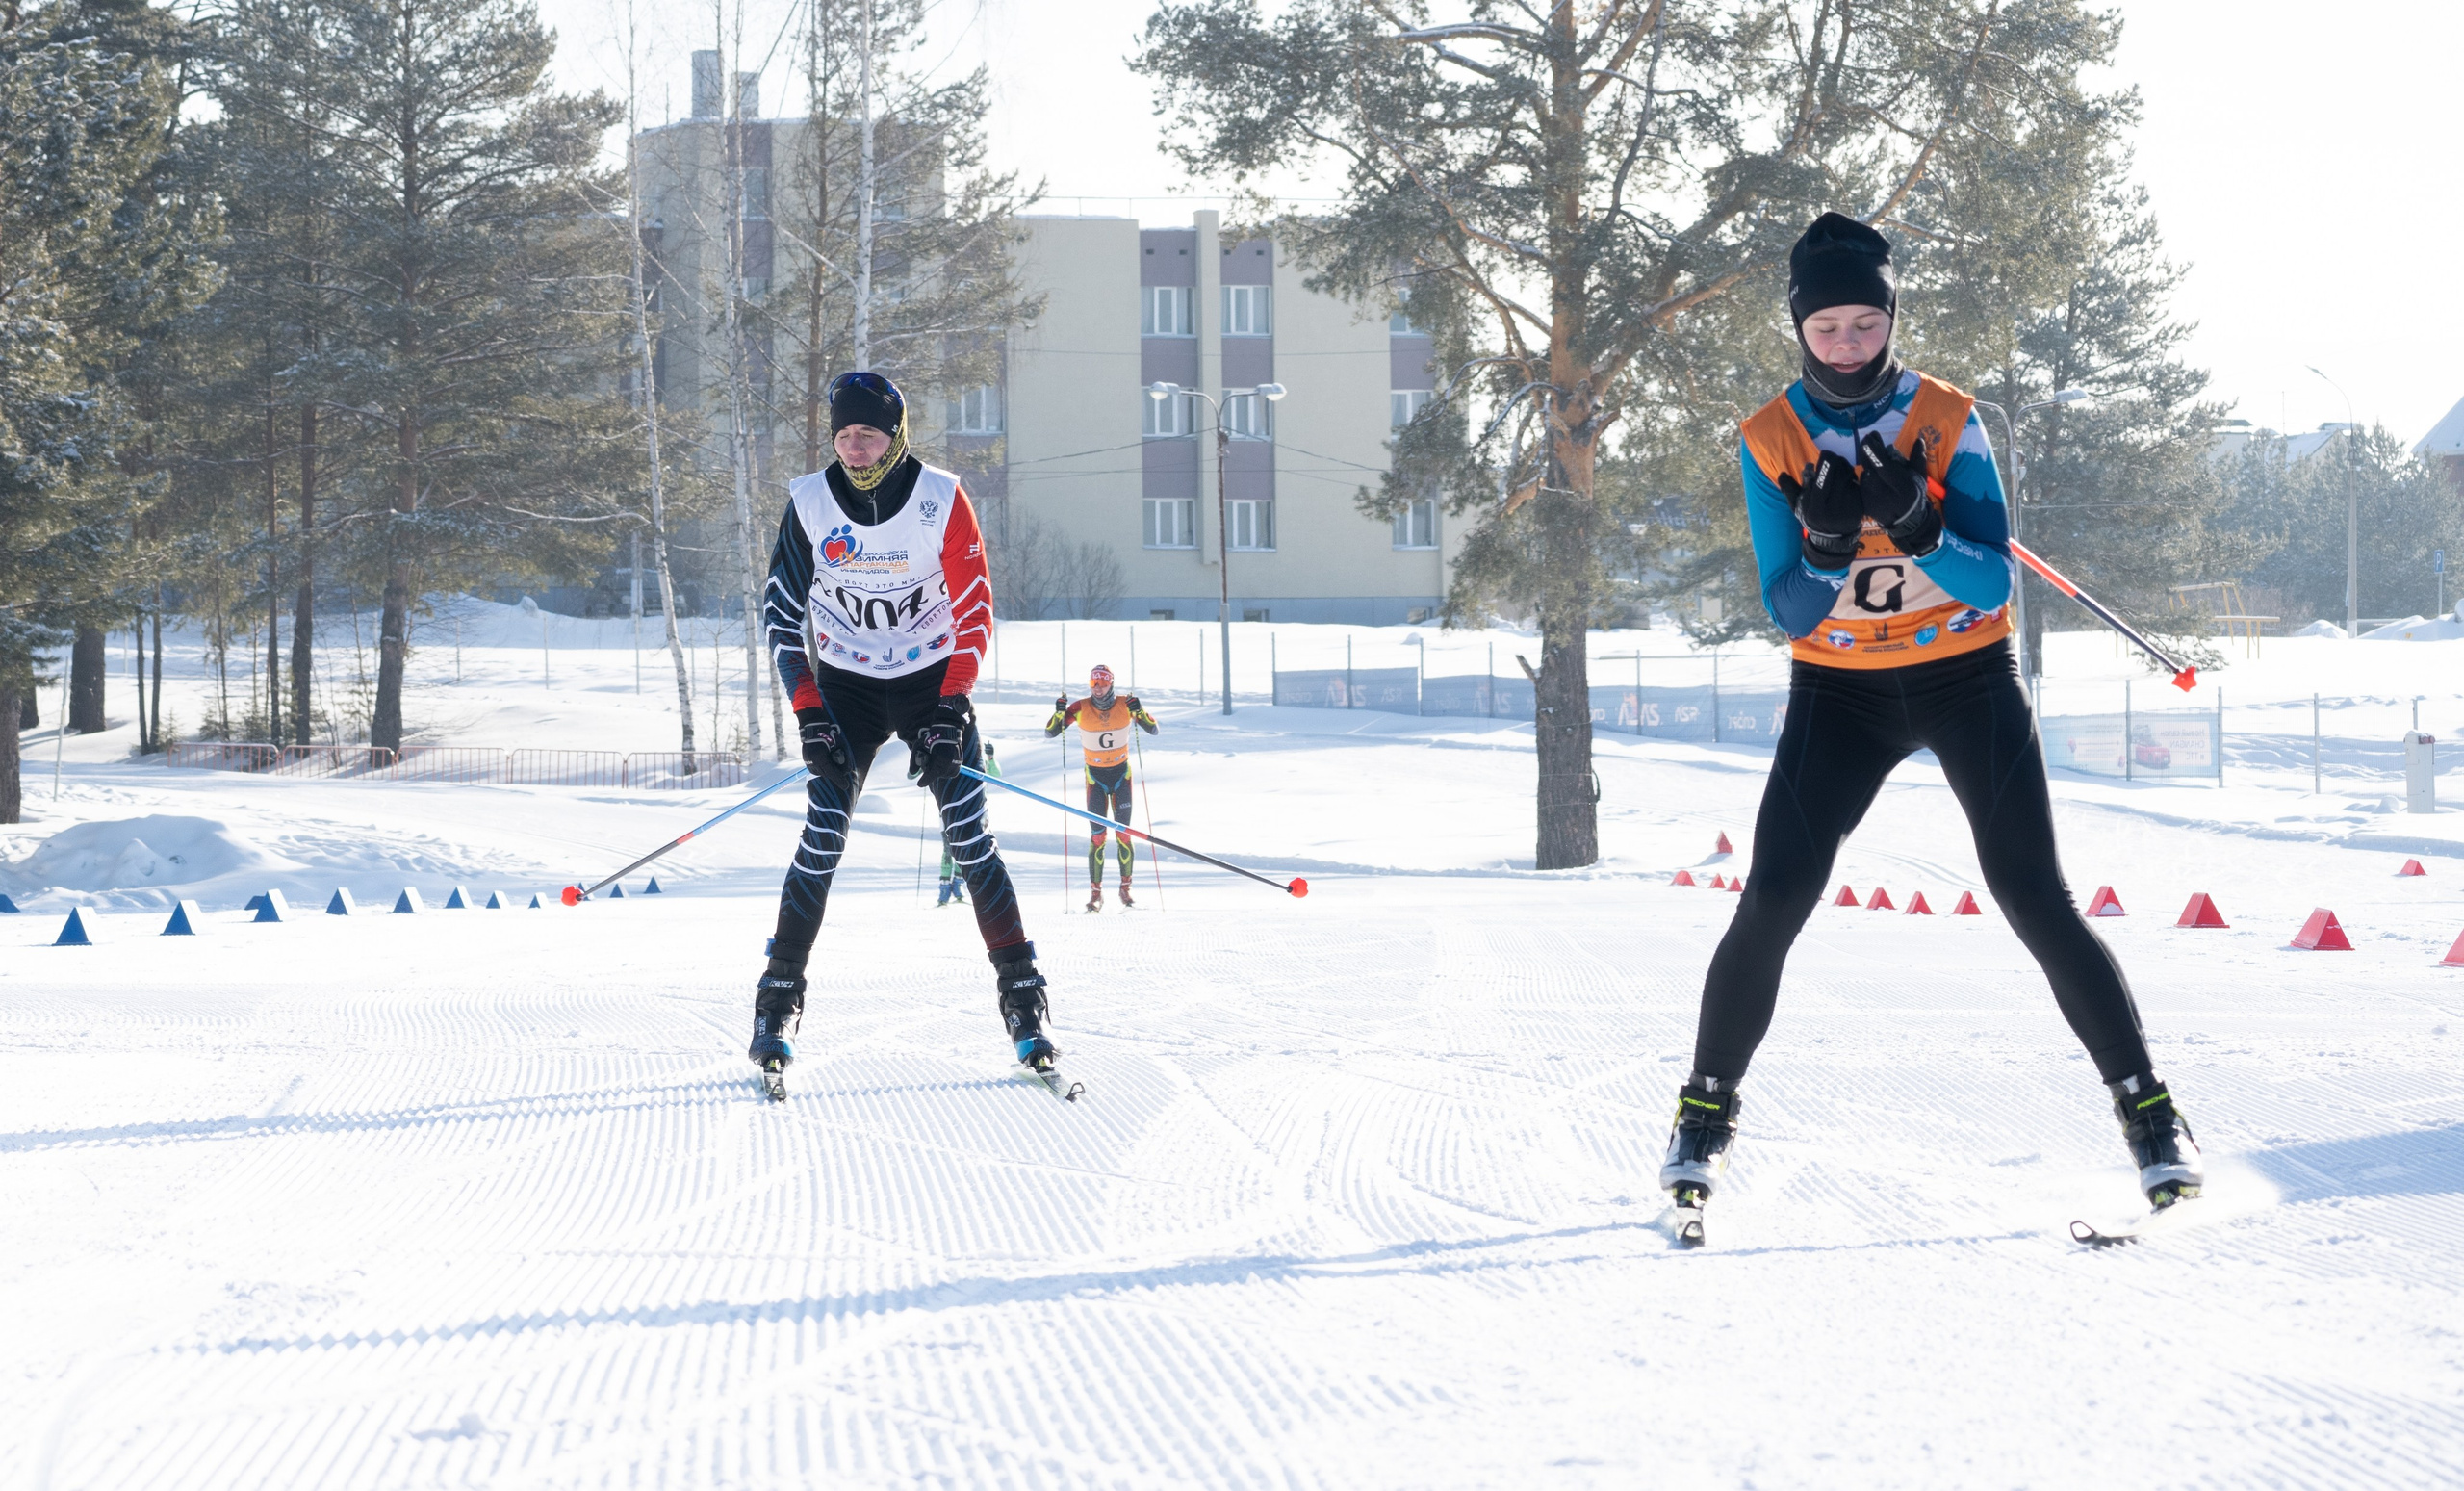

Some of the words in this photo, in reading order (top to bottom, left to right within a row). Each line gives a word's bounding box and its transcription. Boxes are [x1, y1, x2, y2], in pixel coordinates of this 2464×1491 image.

[1854, 564, 1907, 613] G
[1098, 733, 1115, 749] G
[1683, 1097, 1721, 1111] FISCHER
